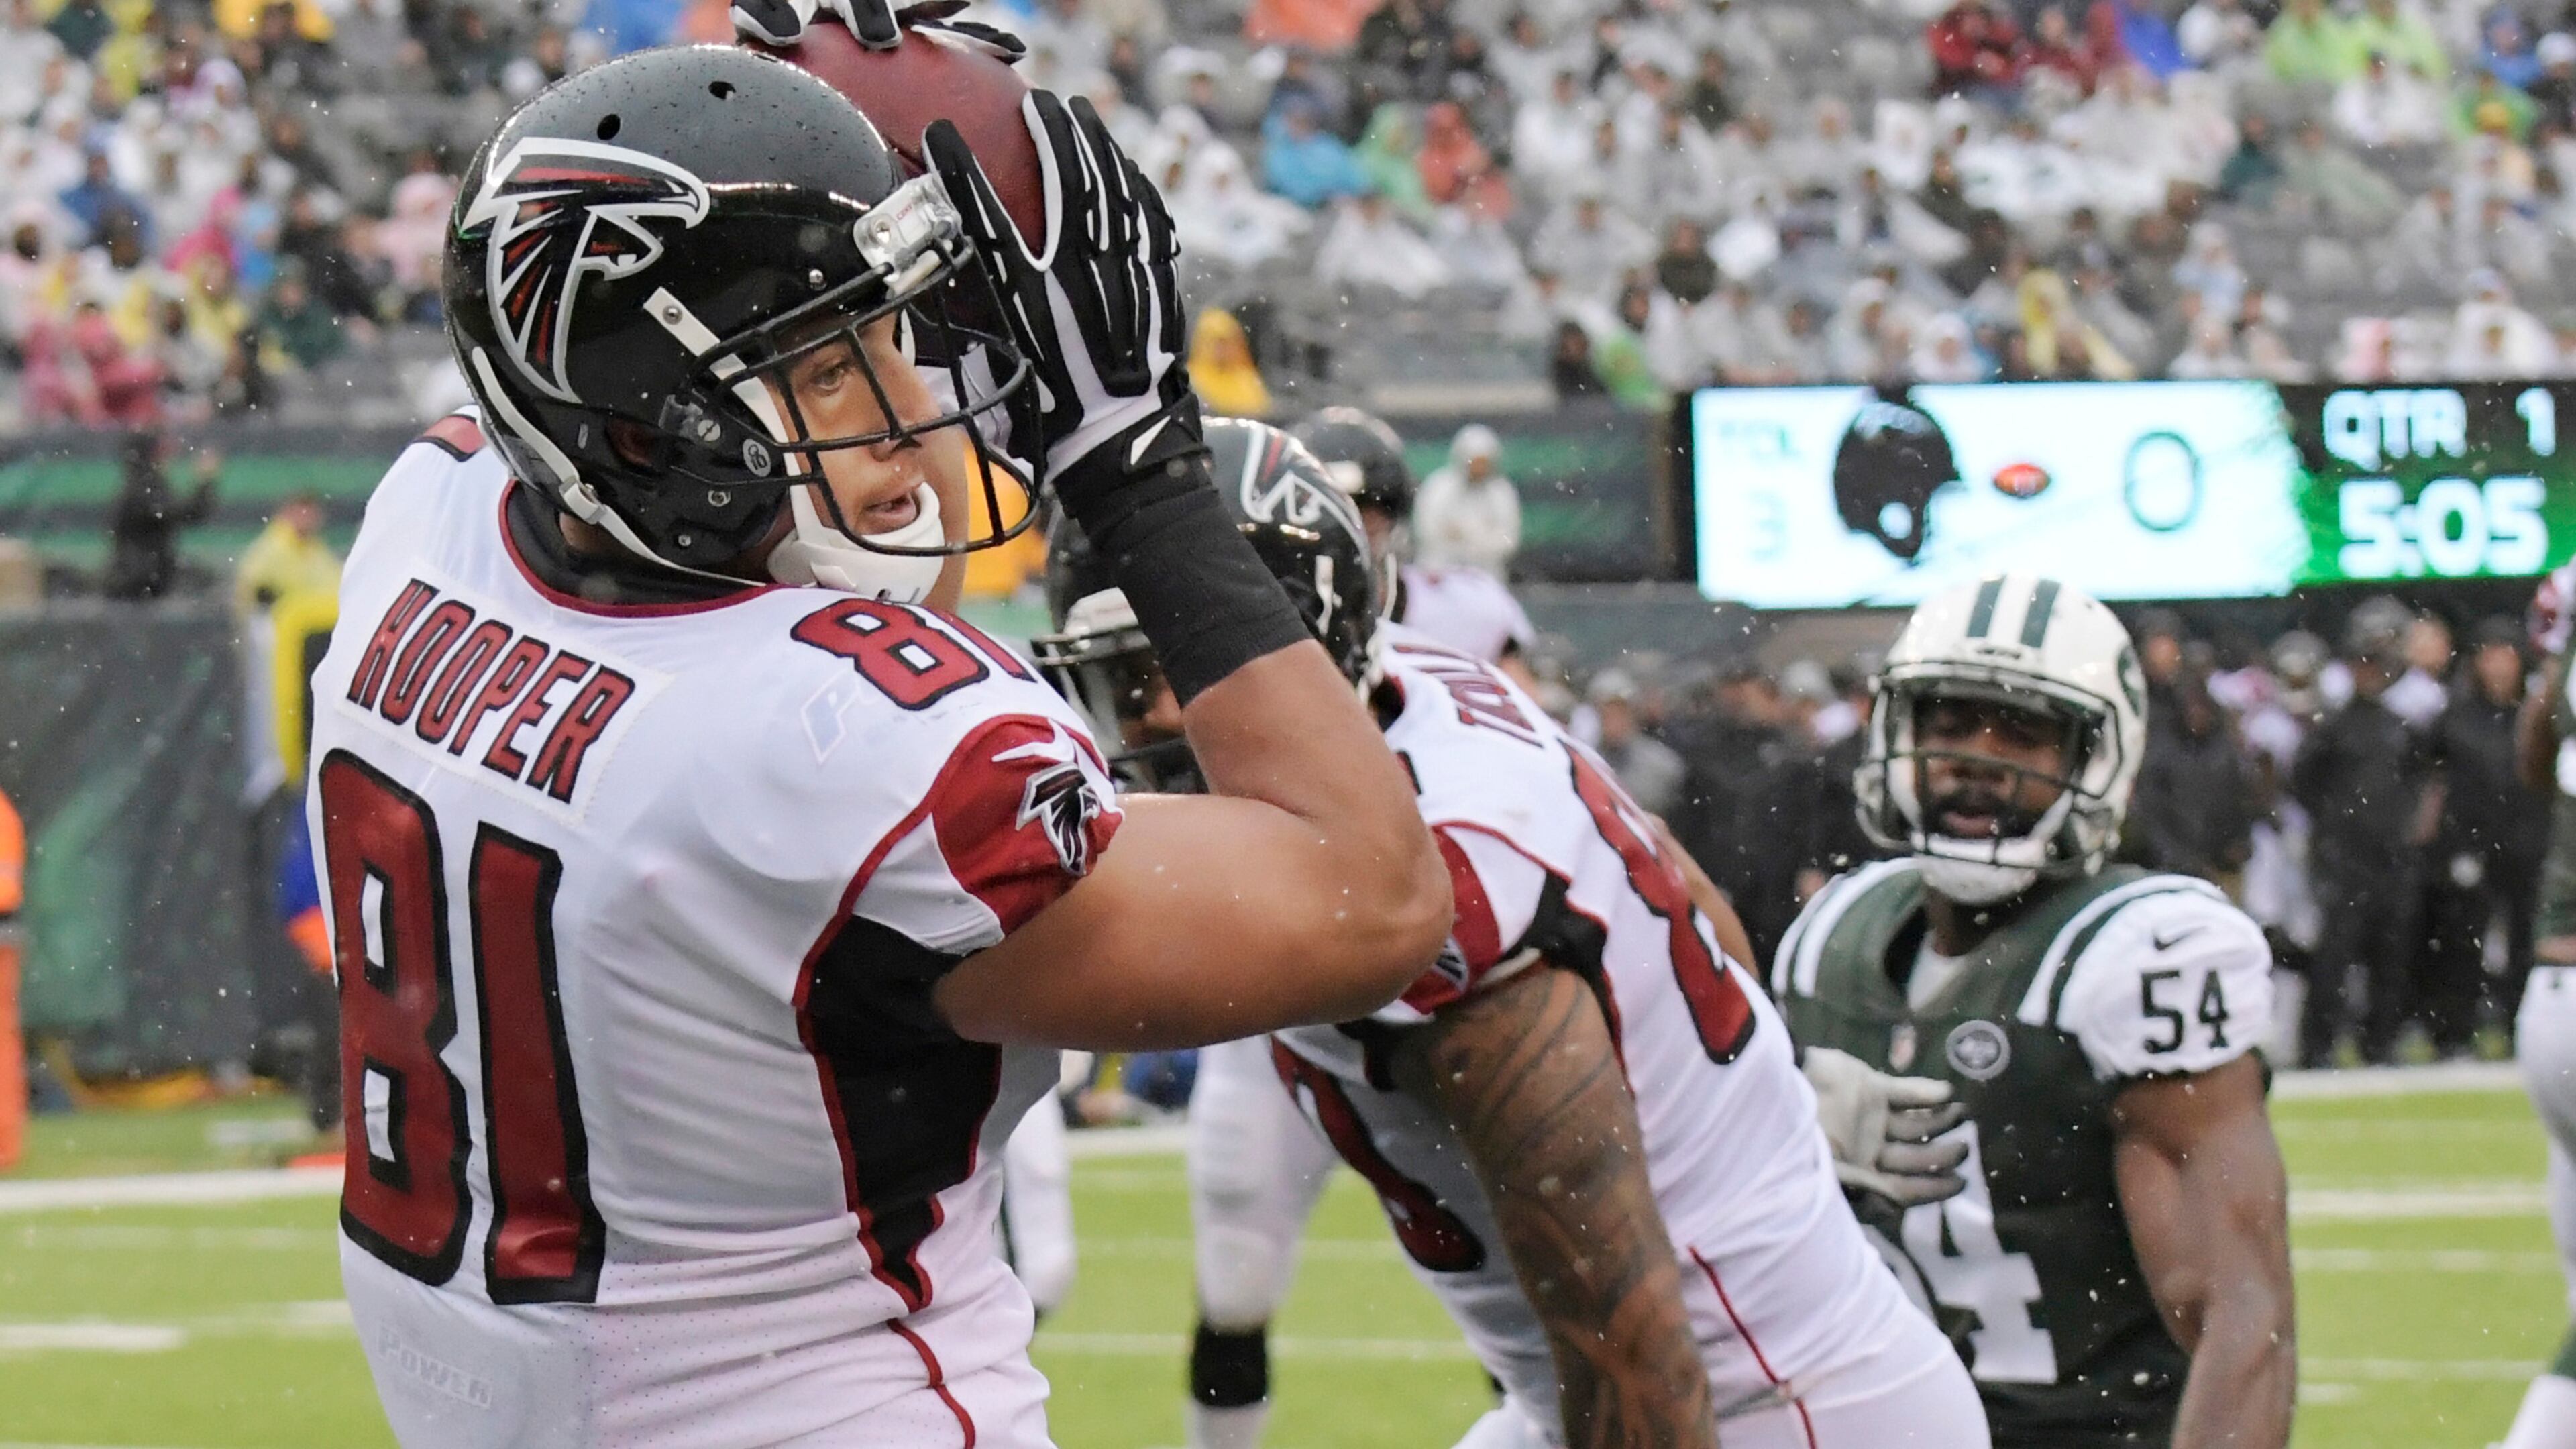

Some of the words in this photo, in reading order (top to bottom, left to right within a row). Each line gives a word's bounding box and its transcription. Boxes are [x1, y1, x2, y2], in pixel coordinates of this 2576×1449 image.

[2323, 388, 2467, 471] QTR
[2516, 387, 2556, 456] 1
[2125, 431, 2202, 531] 0
[2338, 478, 2548, 578] 5:05
[346, 578, 636, 805] HOOPER
[790, 598, 1038, 710] 81
[319, 747, 606, 1305] 81
[2140, 969, 2230, 1053] 54
